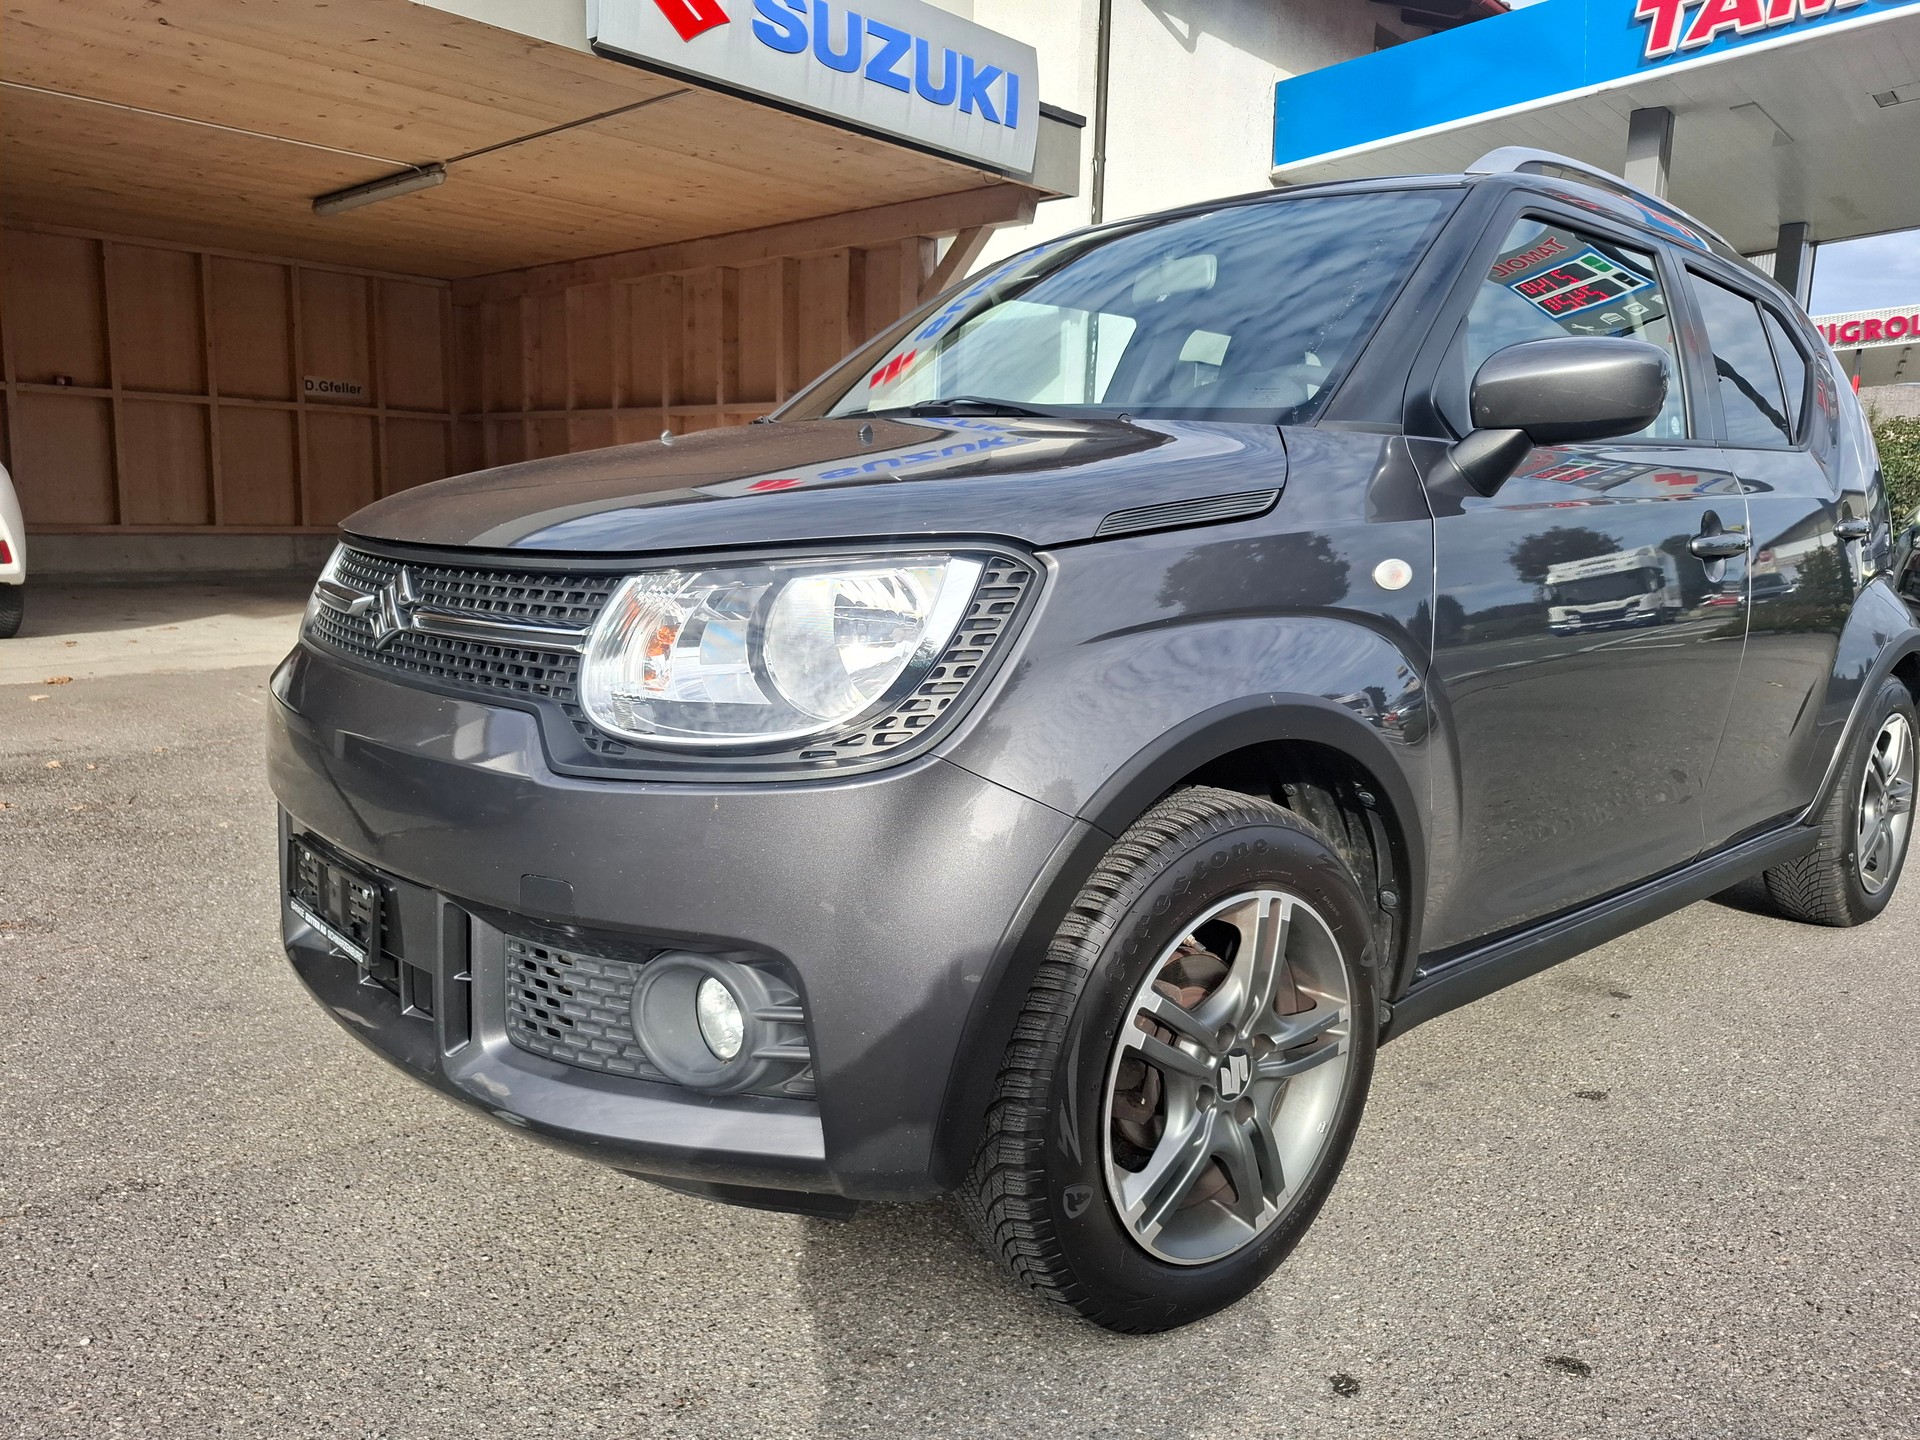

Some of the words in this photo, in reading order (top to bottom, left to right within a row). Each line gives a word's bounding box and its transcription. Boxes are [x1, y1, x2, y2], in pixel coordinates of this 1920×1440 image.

[1634, 0, 1868, 59] TA
[752, 0, 1018, 129] SUZUKI
[1817, 314, 1920, 344] IGROL
